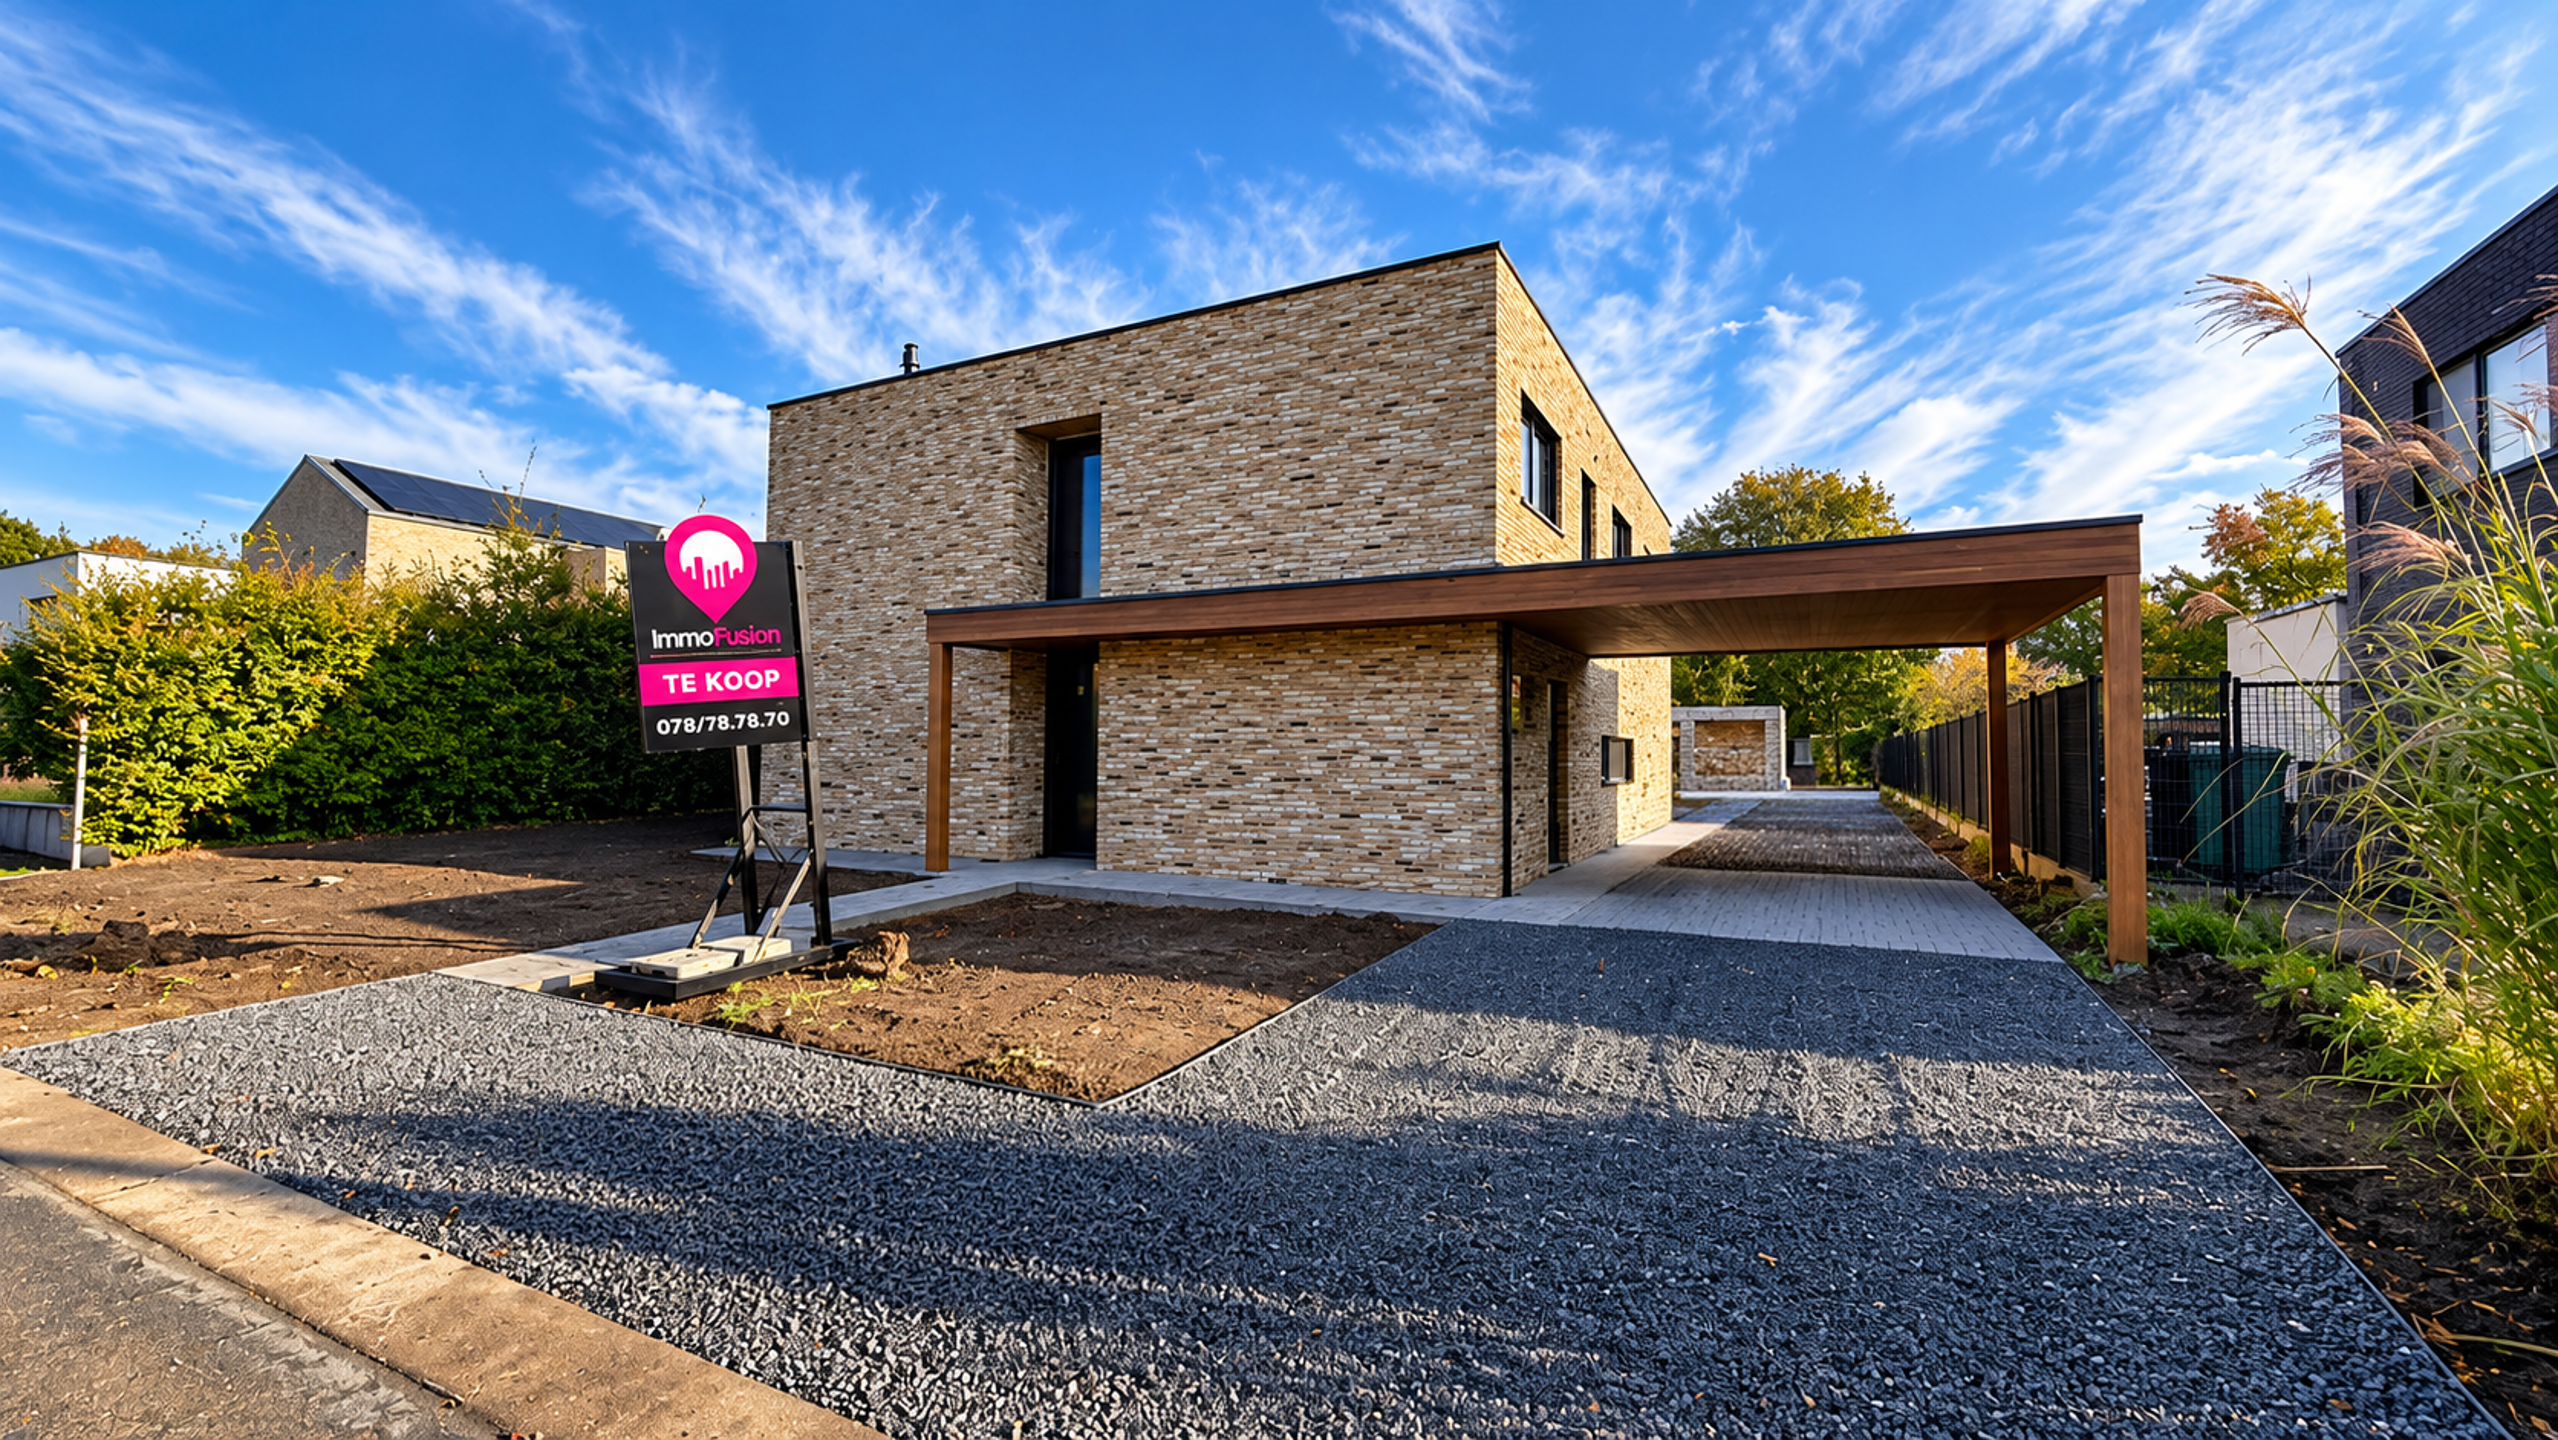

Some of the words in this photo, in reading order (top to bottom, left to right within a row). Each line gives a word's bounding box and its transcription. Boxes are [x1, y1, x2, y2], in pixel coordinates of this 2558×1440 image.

[651, 625, 782, 649] ImmoFusion
[662, 673, 697, 694] TE
[704, 669, 781, 692] KOOP
[656, 710, 791, 735] 078/78.78.70
